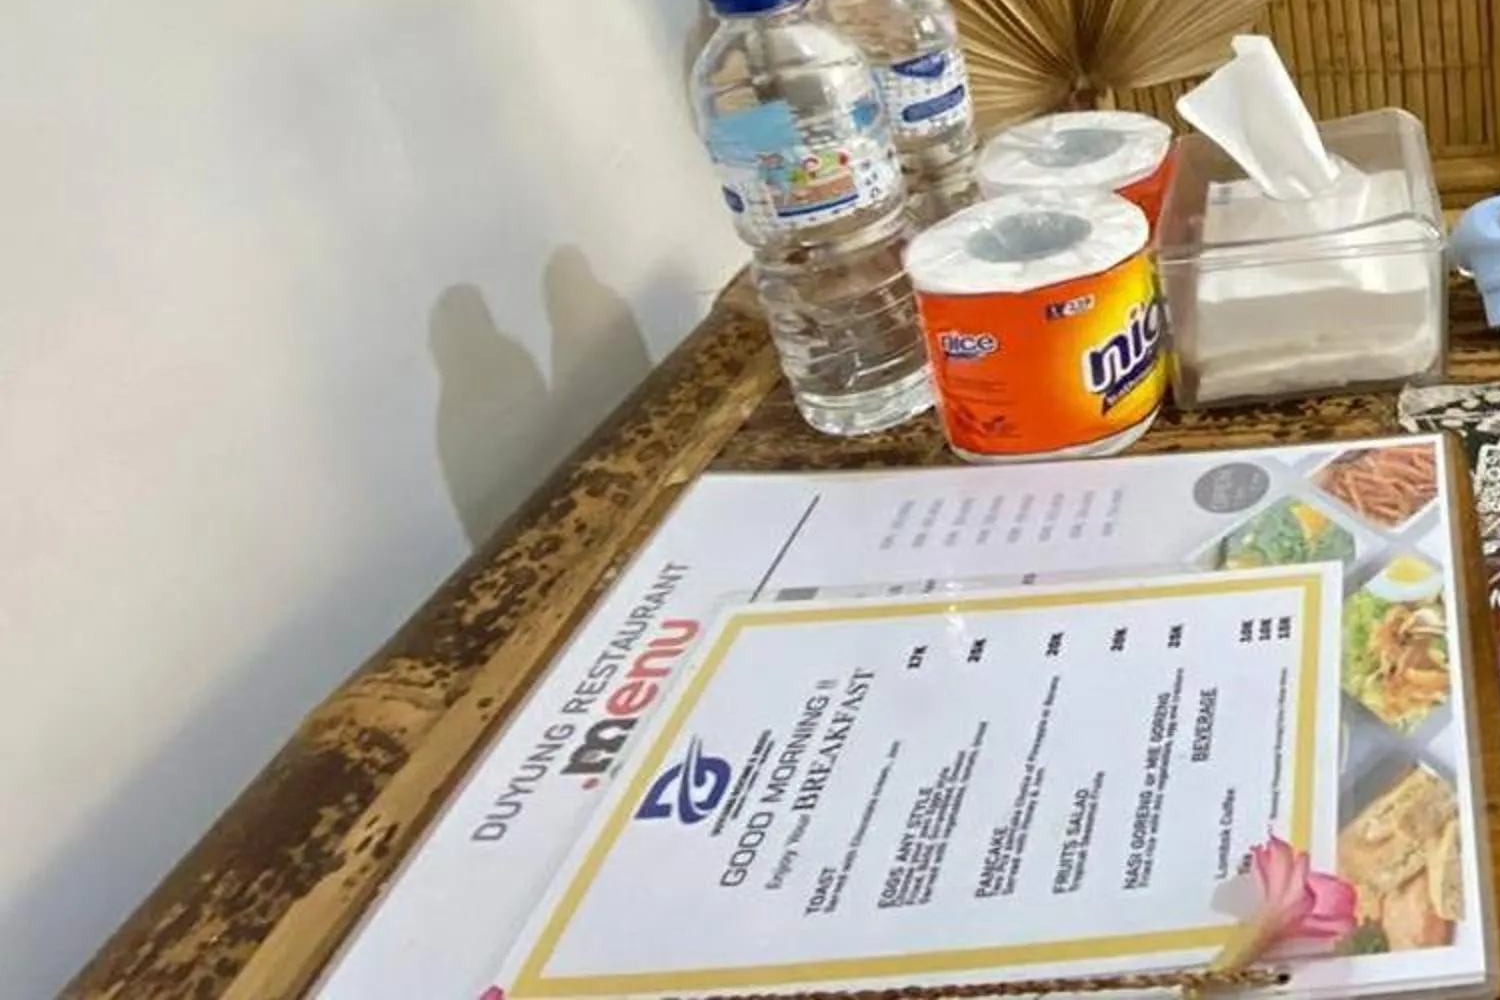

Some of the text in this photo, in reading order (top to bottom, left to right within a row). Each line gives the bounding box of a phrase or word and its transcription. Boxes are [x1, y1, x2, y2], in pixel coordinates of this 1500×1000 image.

[1087, 304, 1165, 391] nic
[472, 562, 687, 840] DUYUNG RESTAURANT
[1149, 691, 1171, 742] GORENG
[1189, 686, 1217, 763] BEVERAGE
[716, 810, 778, 887] GOOD
[756, 694, 833, 803] MORNING
[764, 665, 880, 890] Enjoy Your BREAKFAST
[903, 786, 934, 829] STYLE
[892, 832, 918, 863] ANY
[1051, 788, 1091, 893] FRUITS SALAD
[1129, 790, 1154, 849] GORENG
[803, 865, 840, 914] TOAST
[973, 826, 1010, 898] PANCAKE
[1121, 853, 1143, 889] NASI
